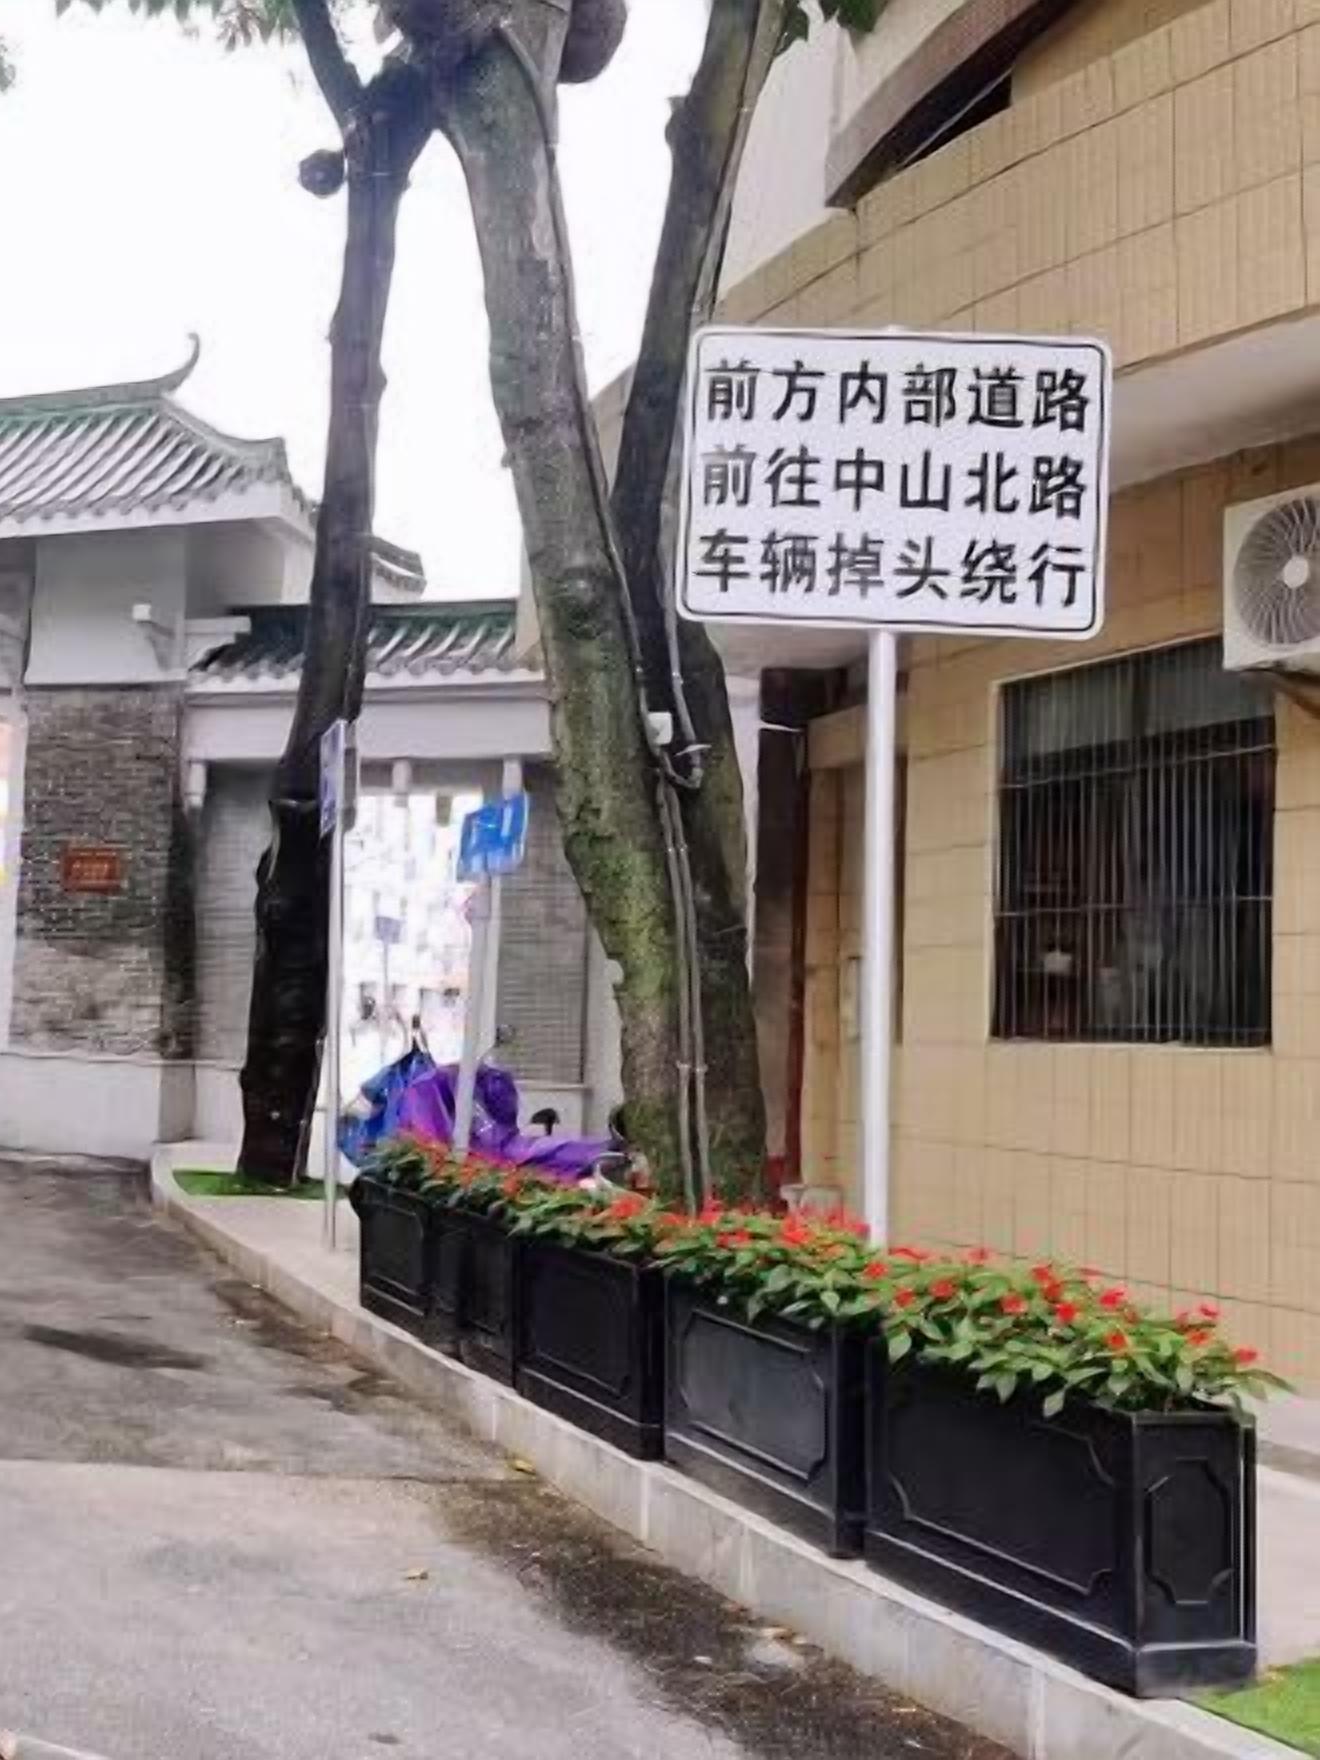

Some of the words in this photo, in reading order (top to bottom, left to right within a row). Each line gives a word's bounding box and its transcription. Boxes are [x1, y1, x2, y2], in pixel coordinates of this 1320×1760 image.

[705, 359, 1090, 432] 前方内部道路
[700, 445, 1087, 519] 前往中山北路
[694, 528, 1085, 607] 车辆掉头绕行
